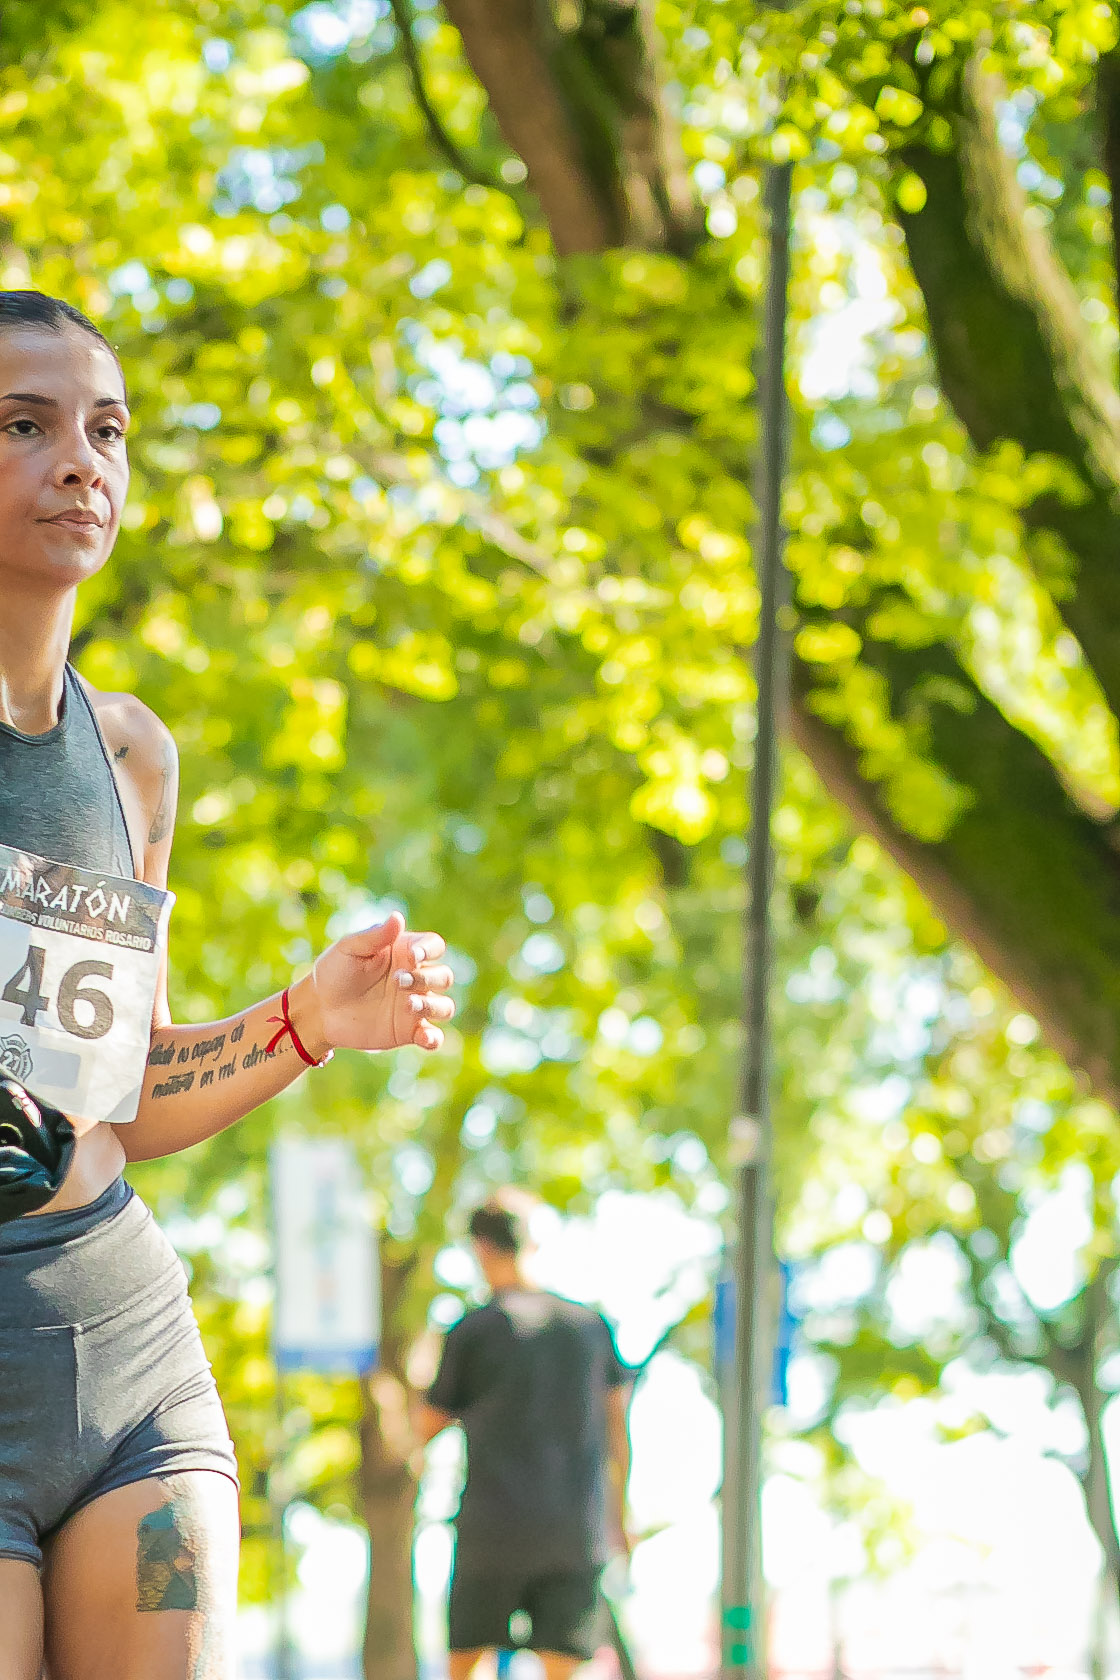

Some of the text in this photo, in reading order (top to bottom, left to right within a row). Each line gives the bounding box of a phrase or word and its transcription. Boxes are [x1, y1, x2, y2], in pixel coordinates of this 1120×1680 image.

[0, 866, 131, 924] MARATÓN
[38, 914, 104, 940] VOLUNTARIOS
[104, 929, 152, 951] ROSARIO
